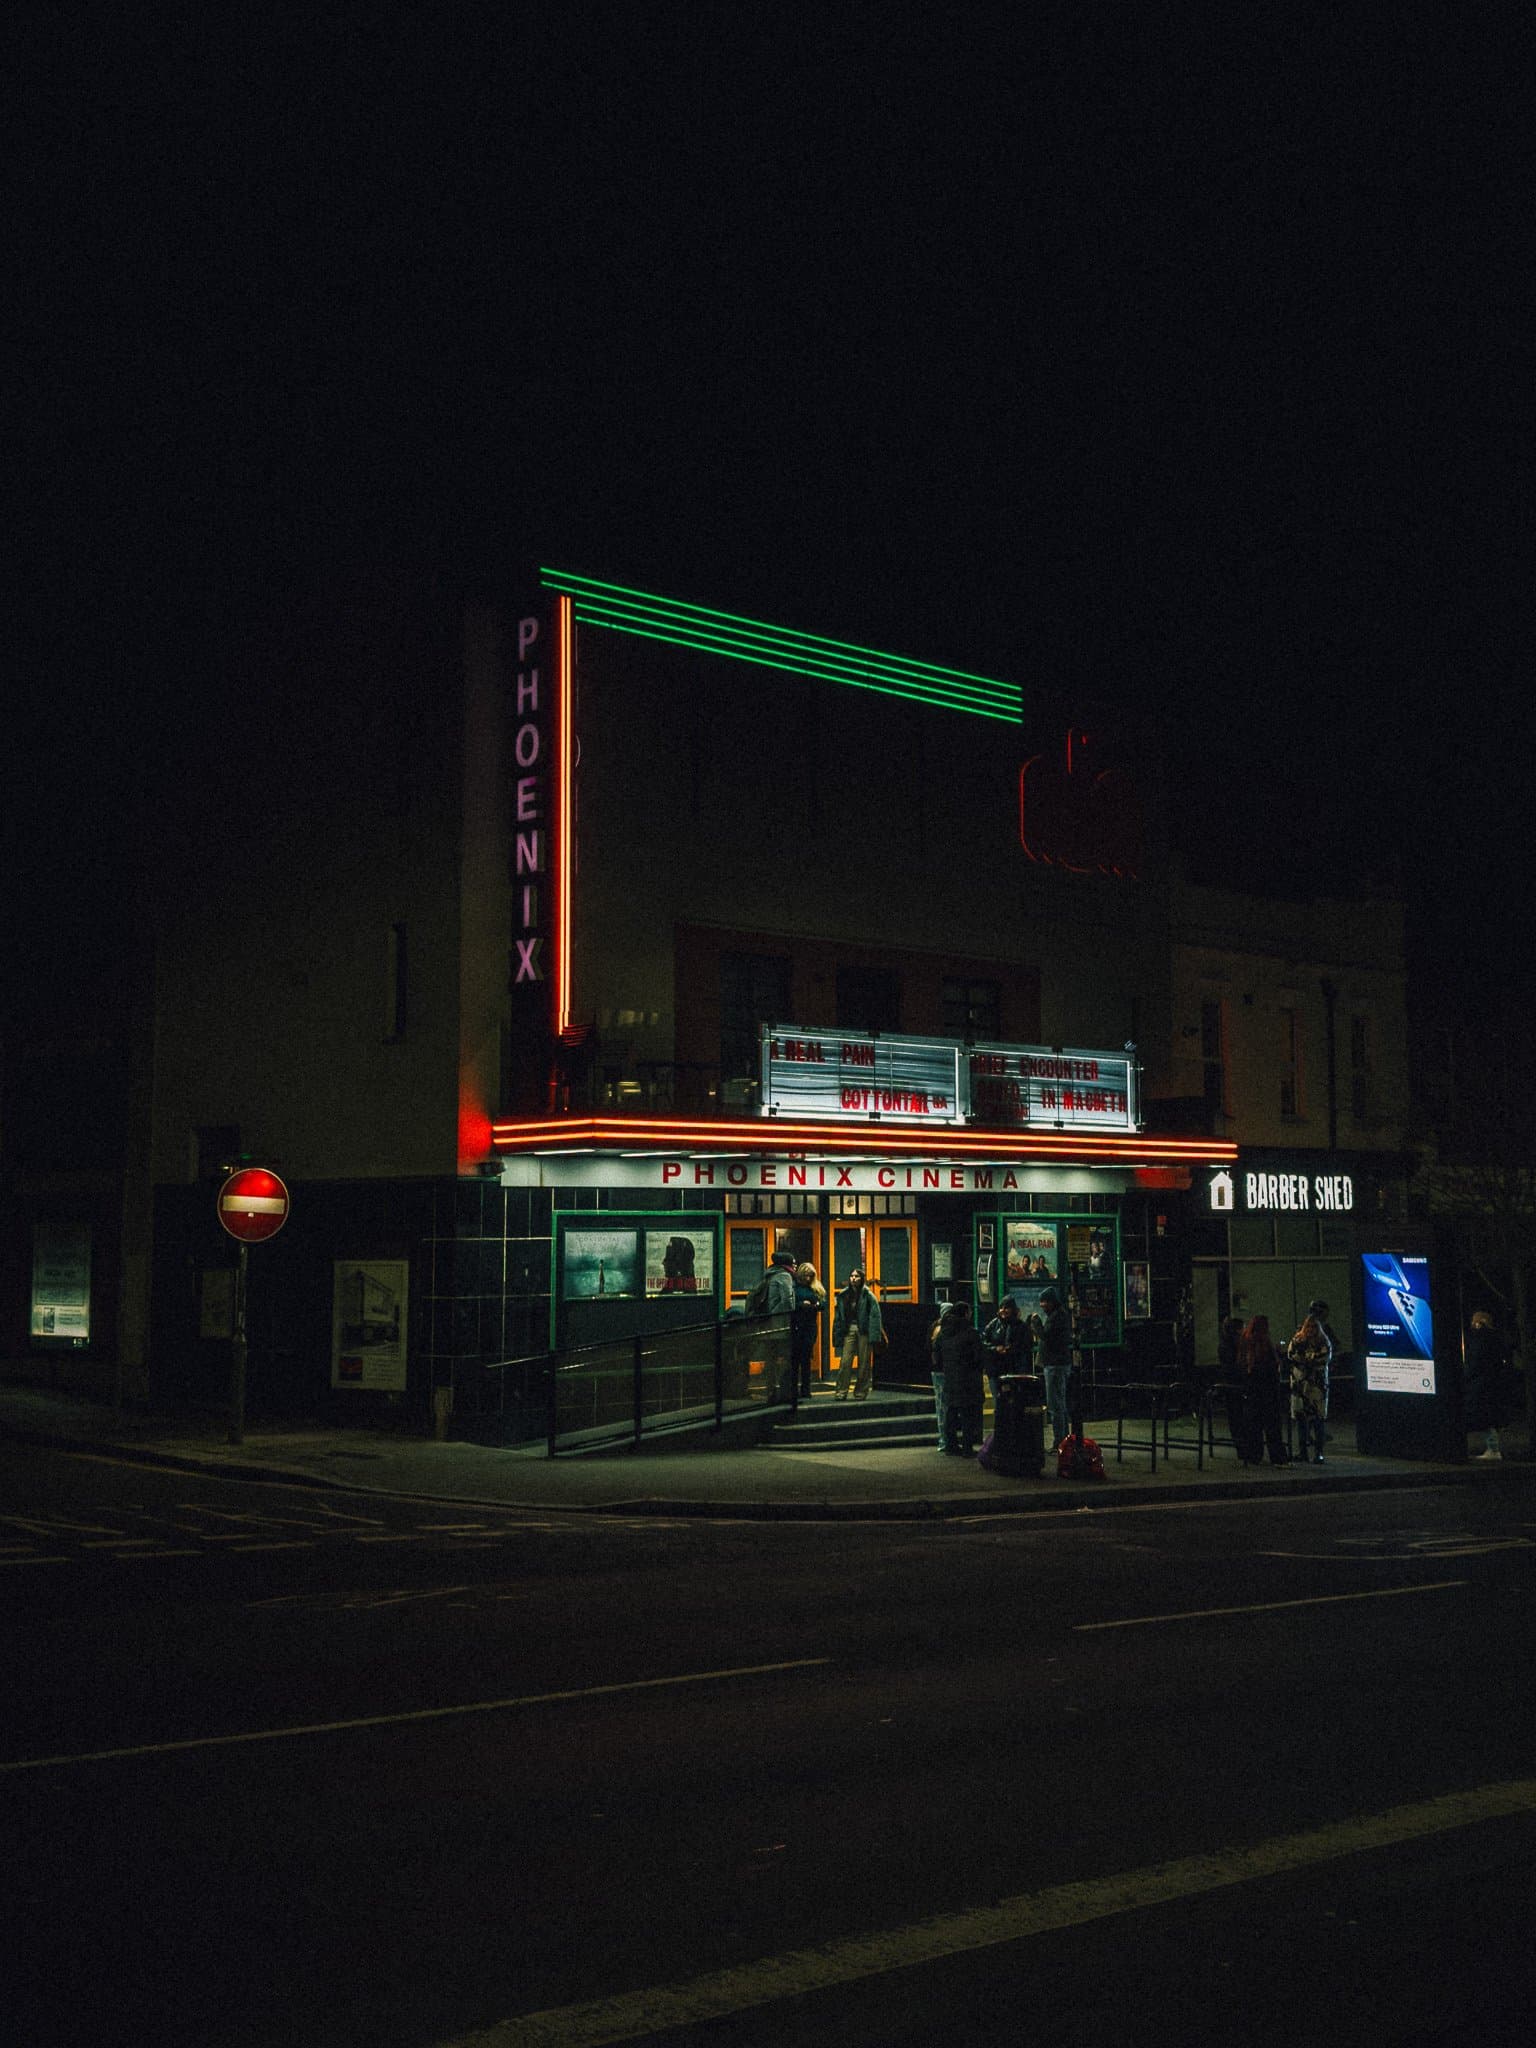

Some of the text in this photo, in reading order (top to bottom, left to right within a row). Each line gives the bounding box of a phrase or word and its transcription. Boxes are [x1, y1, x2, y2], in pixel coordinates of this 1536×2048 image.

[515, 616, 541, 983] PHOENIX
[785, 1040, 826, 1063] REAL
[842, 1044, 875, 1066] PAIN
[1020, 1057, 1099, 1081] ENCOUNTER
[841, 1087, 930, 1114] COTTONTAIL
[1042, 1089, 1055, 1109] IN
[1063, 1090, 1127, 1112] MACBETH
[662, 1162, 1019, 1190] PHOENIX CINEMA
[1246, 1172, 1353, 1210] BARBER SHED
[1017, 1239, 1036, 1249] REAL
